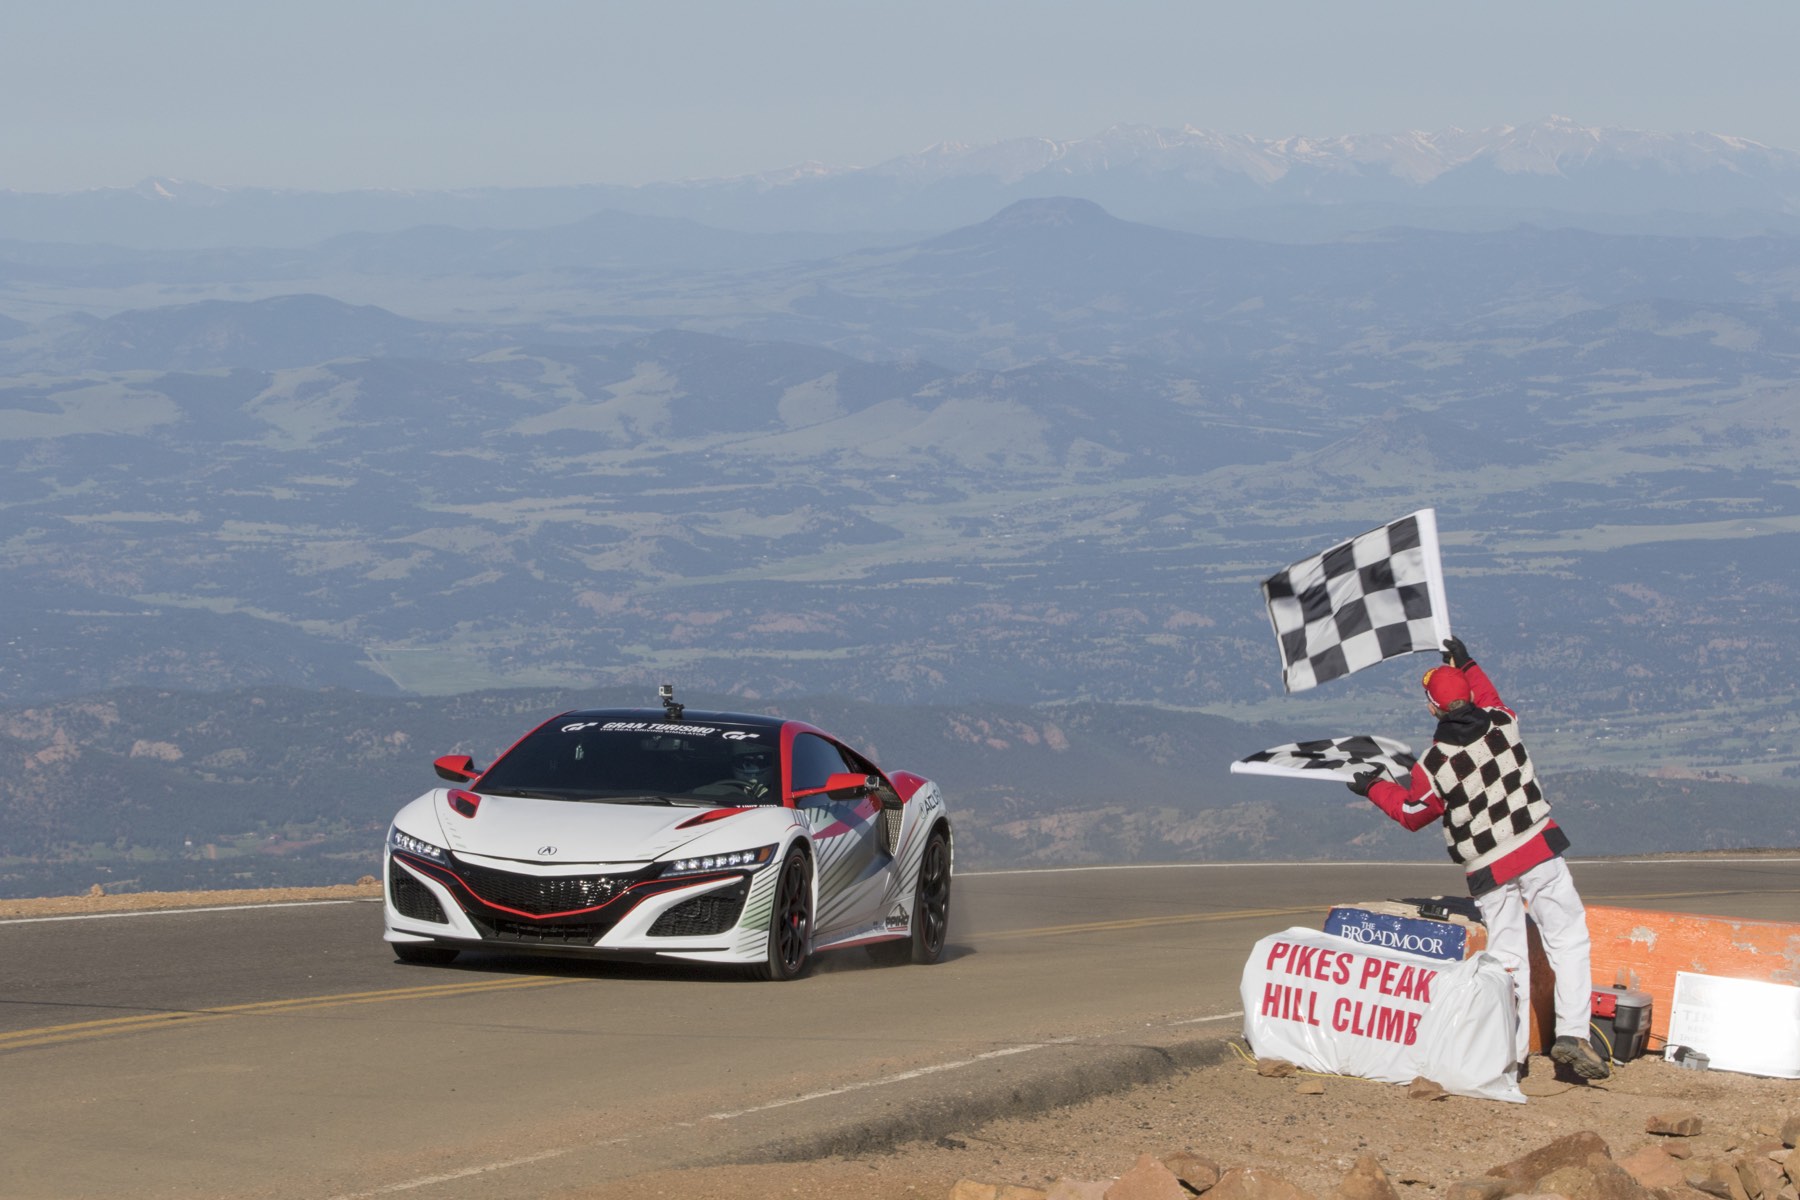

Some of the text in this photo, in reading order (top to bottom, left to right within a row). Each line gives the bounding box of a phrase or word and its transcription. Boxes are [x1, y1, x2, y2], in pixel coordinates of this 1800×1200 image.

[648, 723, 715, 734] TURISMO
[1341, 925, 1444, 955] BROADMOOR
[1361, 921, 1376, 930] THE
[1266, 942, 1438, 1003] PIKES PEAK
[1261, 982, 1422, 1046] HILL CLIMB
